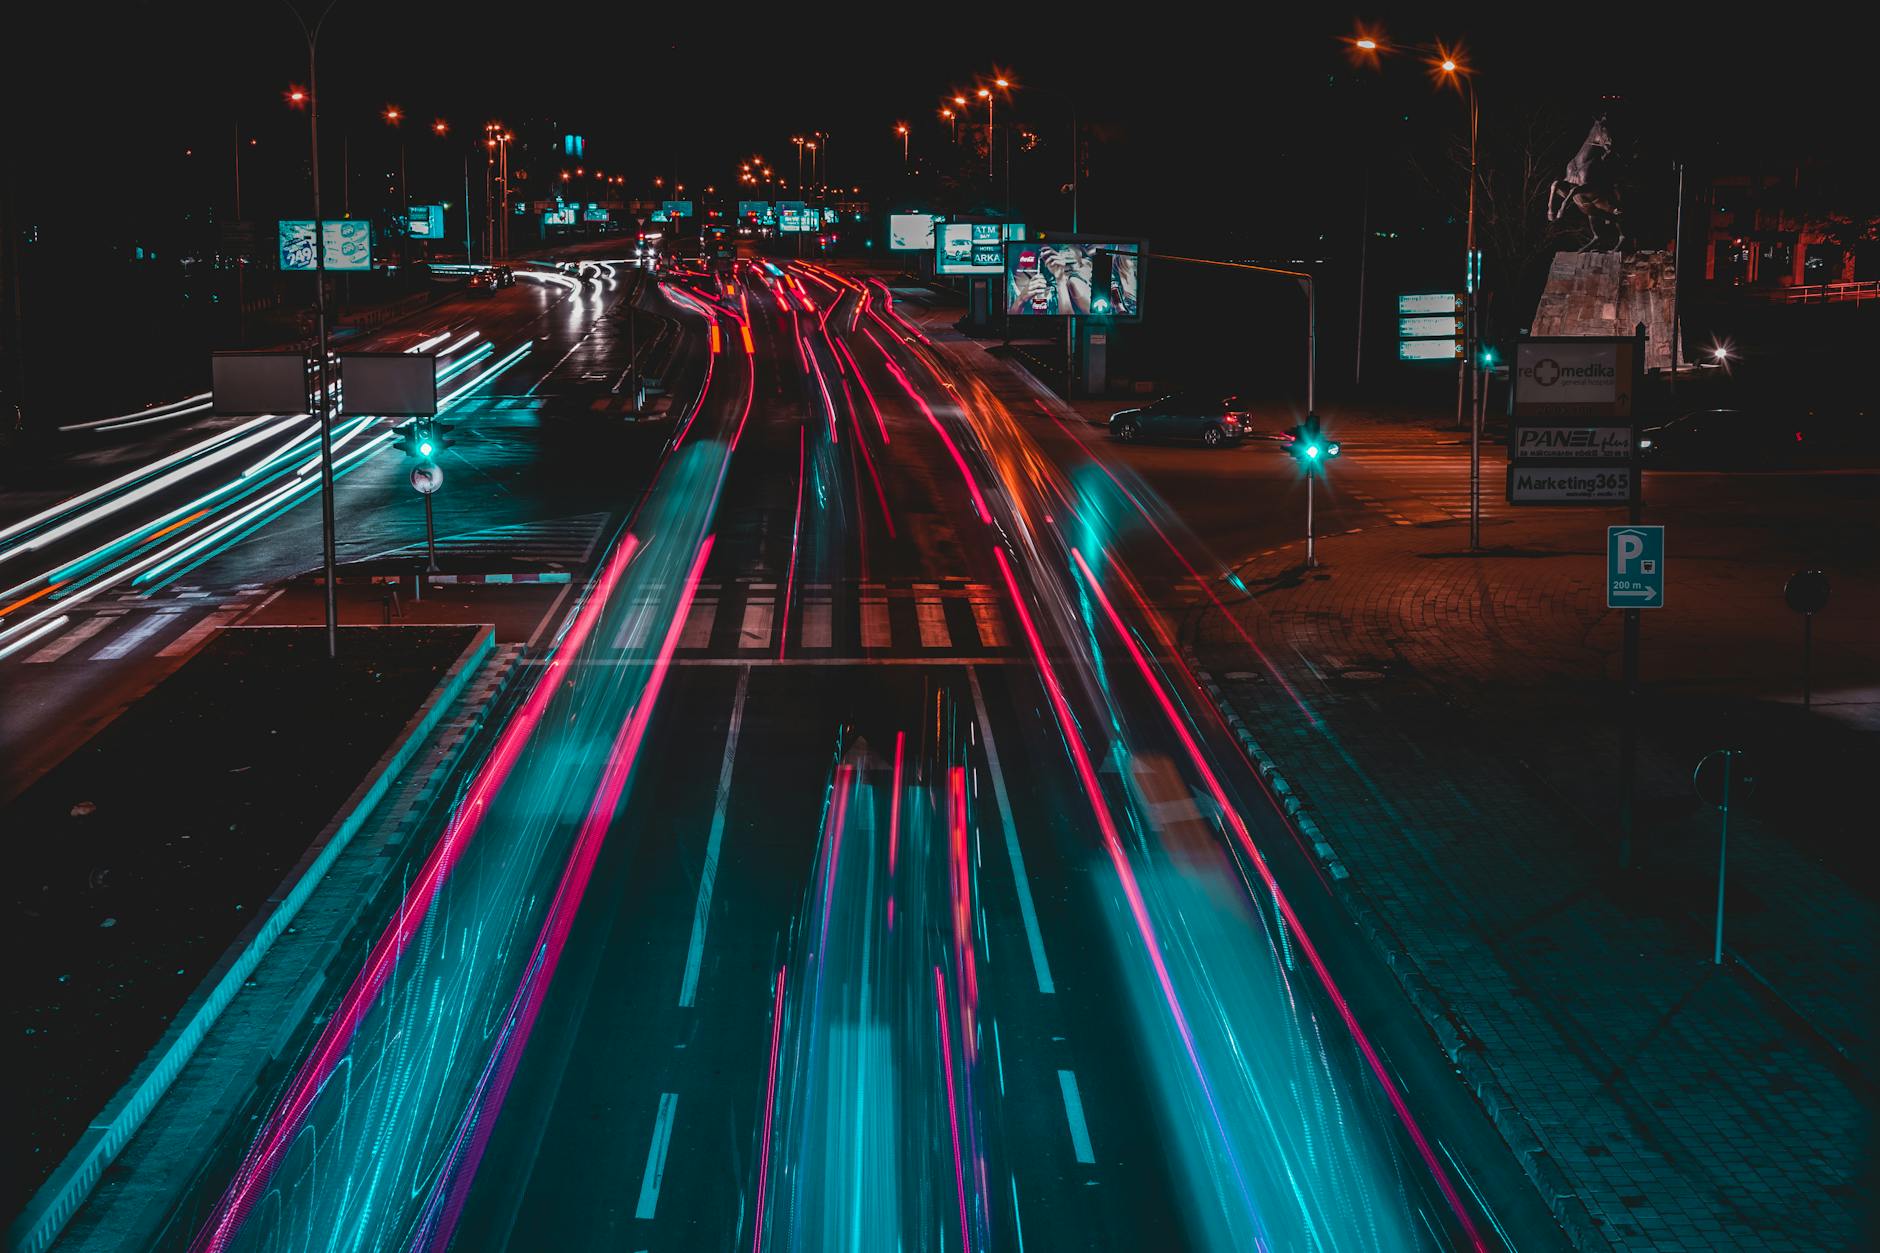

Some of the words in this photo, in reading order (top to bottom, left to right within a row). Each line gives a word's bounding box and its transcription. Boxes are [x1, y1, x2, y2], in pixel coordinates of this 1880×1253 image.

[974, 254, 1001, 262] ARKA
[1561, 364, 1615, 377] medika
[1519, 430, 1600, 447] PANEL
[1600, 431, 1629, 451] plus
[1517, 473, 1629, 491] Marketing365
[1617, 534, 1644, 574] P
[1613, 581, 1630, 589] 200
